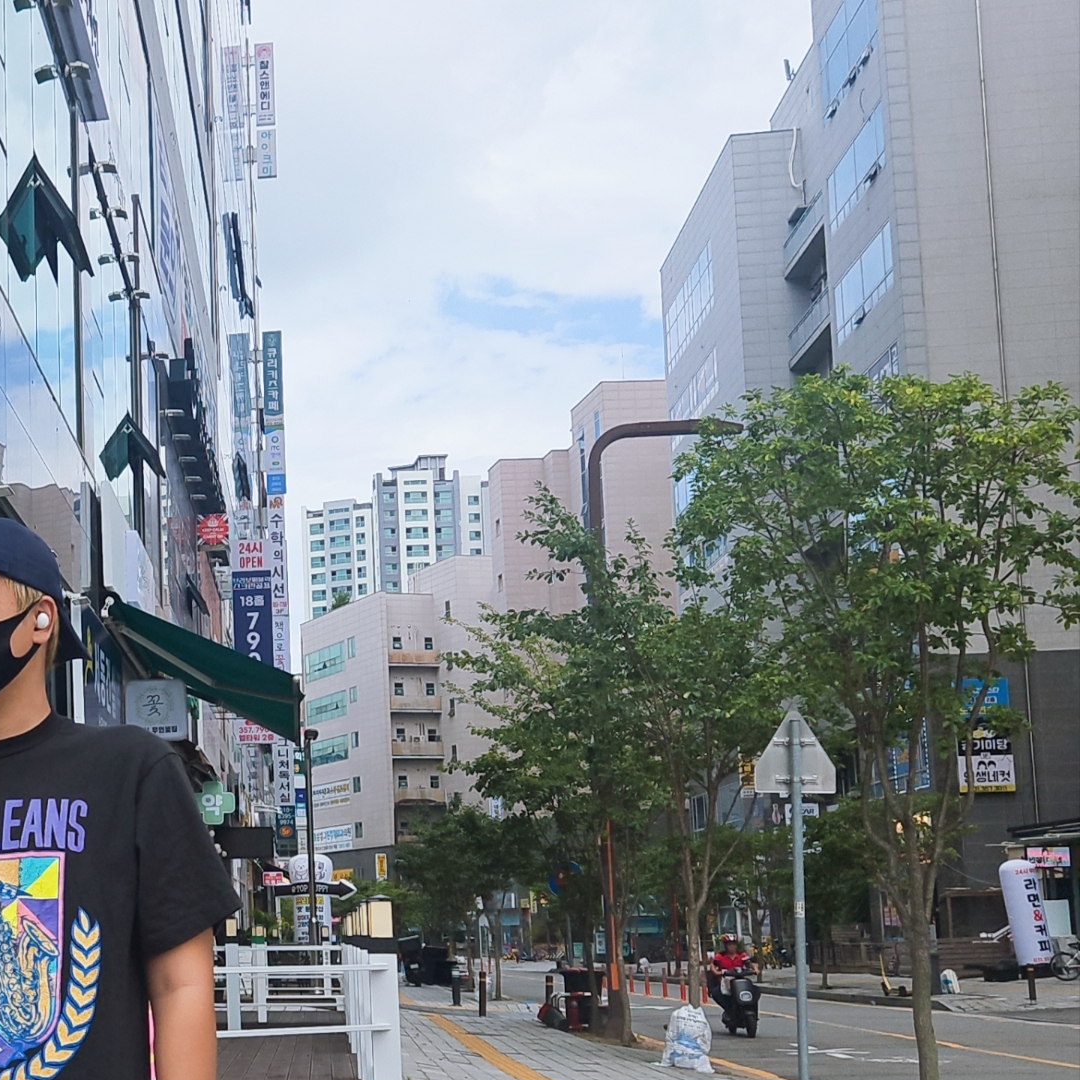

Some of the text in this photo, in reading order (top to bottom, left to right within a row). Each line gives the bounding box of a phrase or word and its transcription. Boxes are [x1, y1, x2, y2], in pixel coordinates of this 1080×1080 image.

[239, 542, 263, 555] 24시
[239, 556, 263, 569] OPEN
[270, 513, 285, 599] 수학의시선
[239, 594, 265, 607] 18홀
[201, 794, 223, 816] 약
